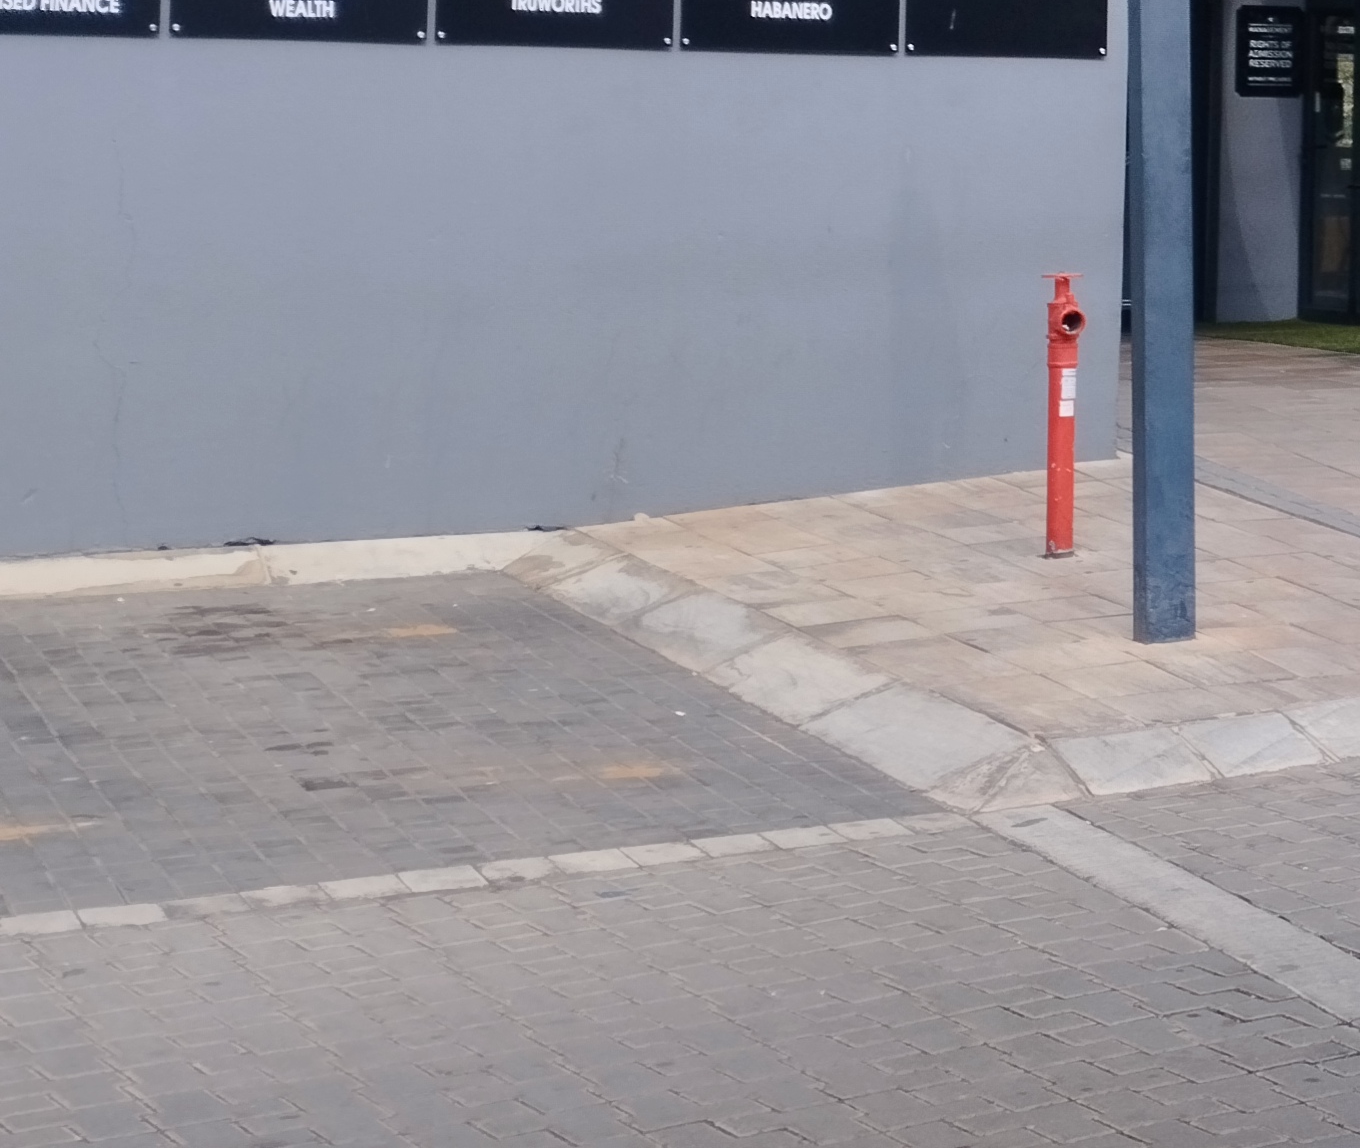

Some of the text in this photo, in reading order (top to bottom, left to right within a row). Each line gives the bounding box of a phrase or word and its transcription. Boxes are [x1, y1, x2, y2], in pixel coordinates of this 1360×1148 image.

[268, 0, 337, 19] WEALTH
[750, 0, 833, 21] HABANERO
[1247, 49, 1293, 59] ADMISSION
[1248, 58, 1293, 68] RESERVED
